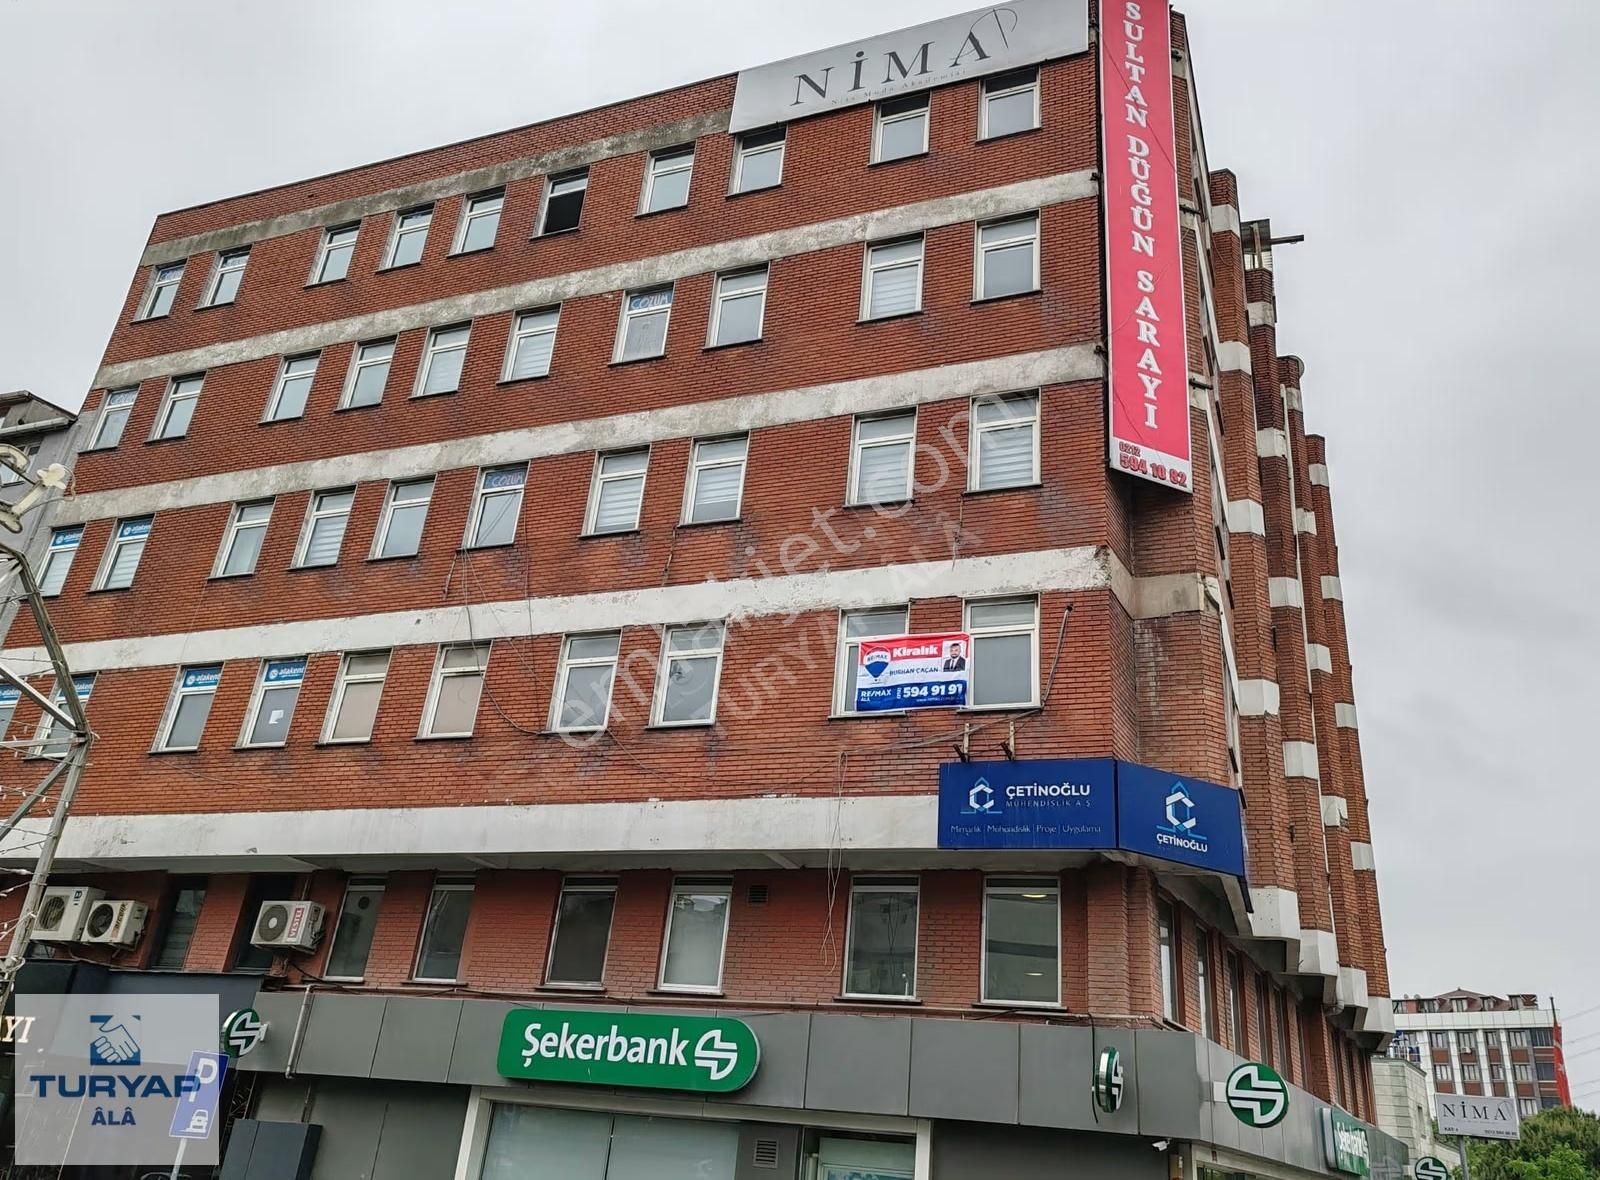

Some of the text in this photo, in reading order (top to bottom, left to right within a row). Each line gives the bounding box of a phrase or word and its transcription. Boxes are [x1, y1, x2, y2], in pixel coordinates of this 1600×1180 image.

[1123, 2, 1148, 128] SULTAN
[1135, 269, 1162, 429] SARAYI
[1120, 453, 1147, 475] 594
[893, 644, 938, 658] Kiralık
[861, 689, 892, 697] RE/MAX
[903, 683, 963, 698] 594 91 91
[1006, 782, 1091, 800] ÇETİNOĞLU
[1156, 833, 1208, 852] ÇETİNOĞLU
[522, 1022, 690, 1068] Şekerbank
